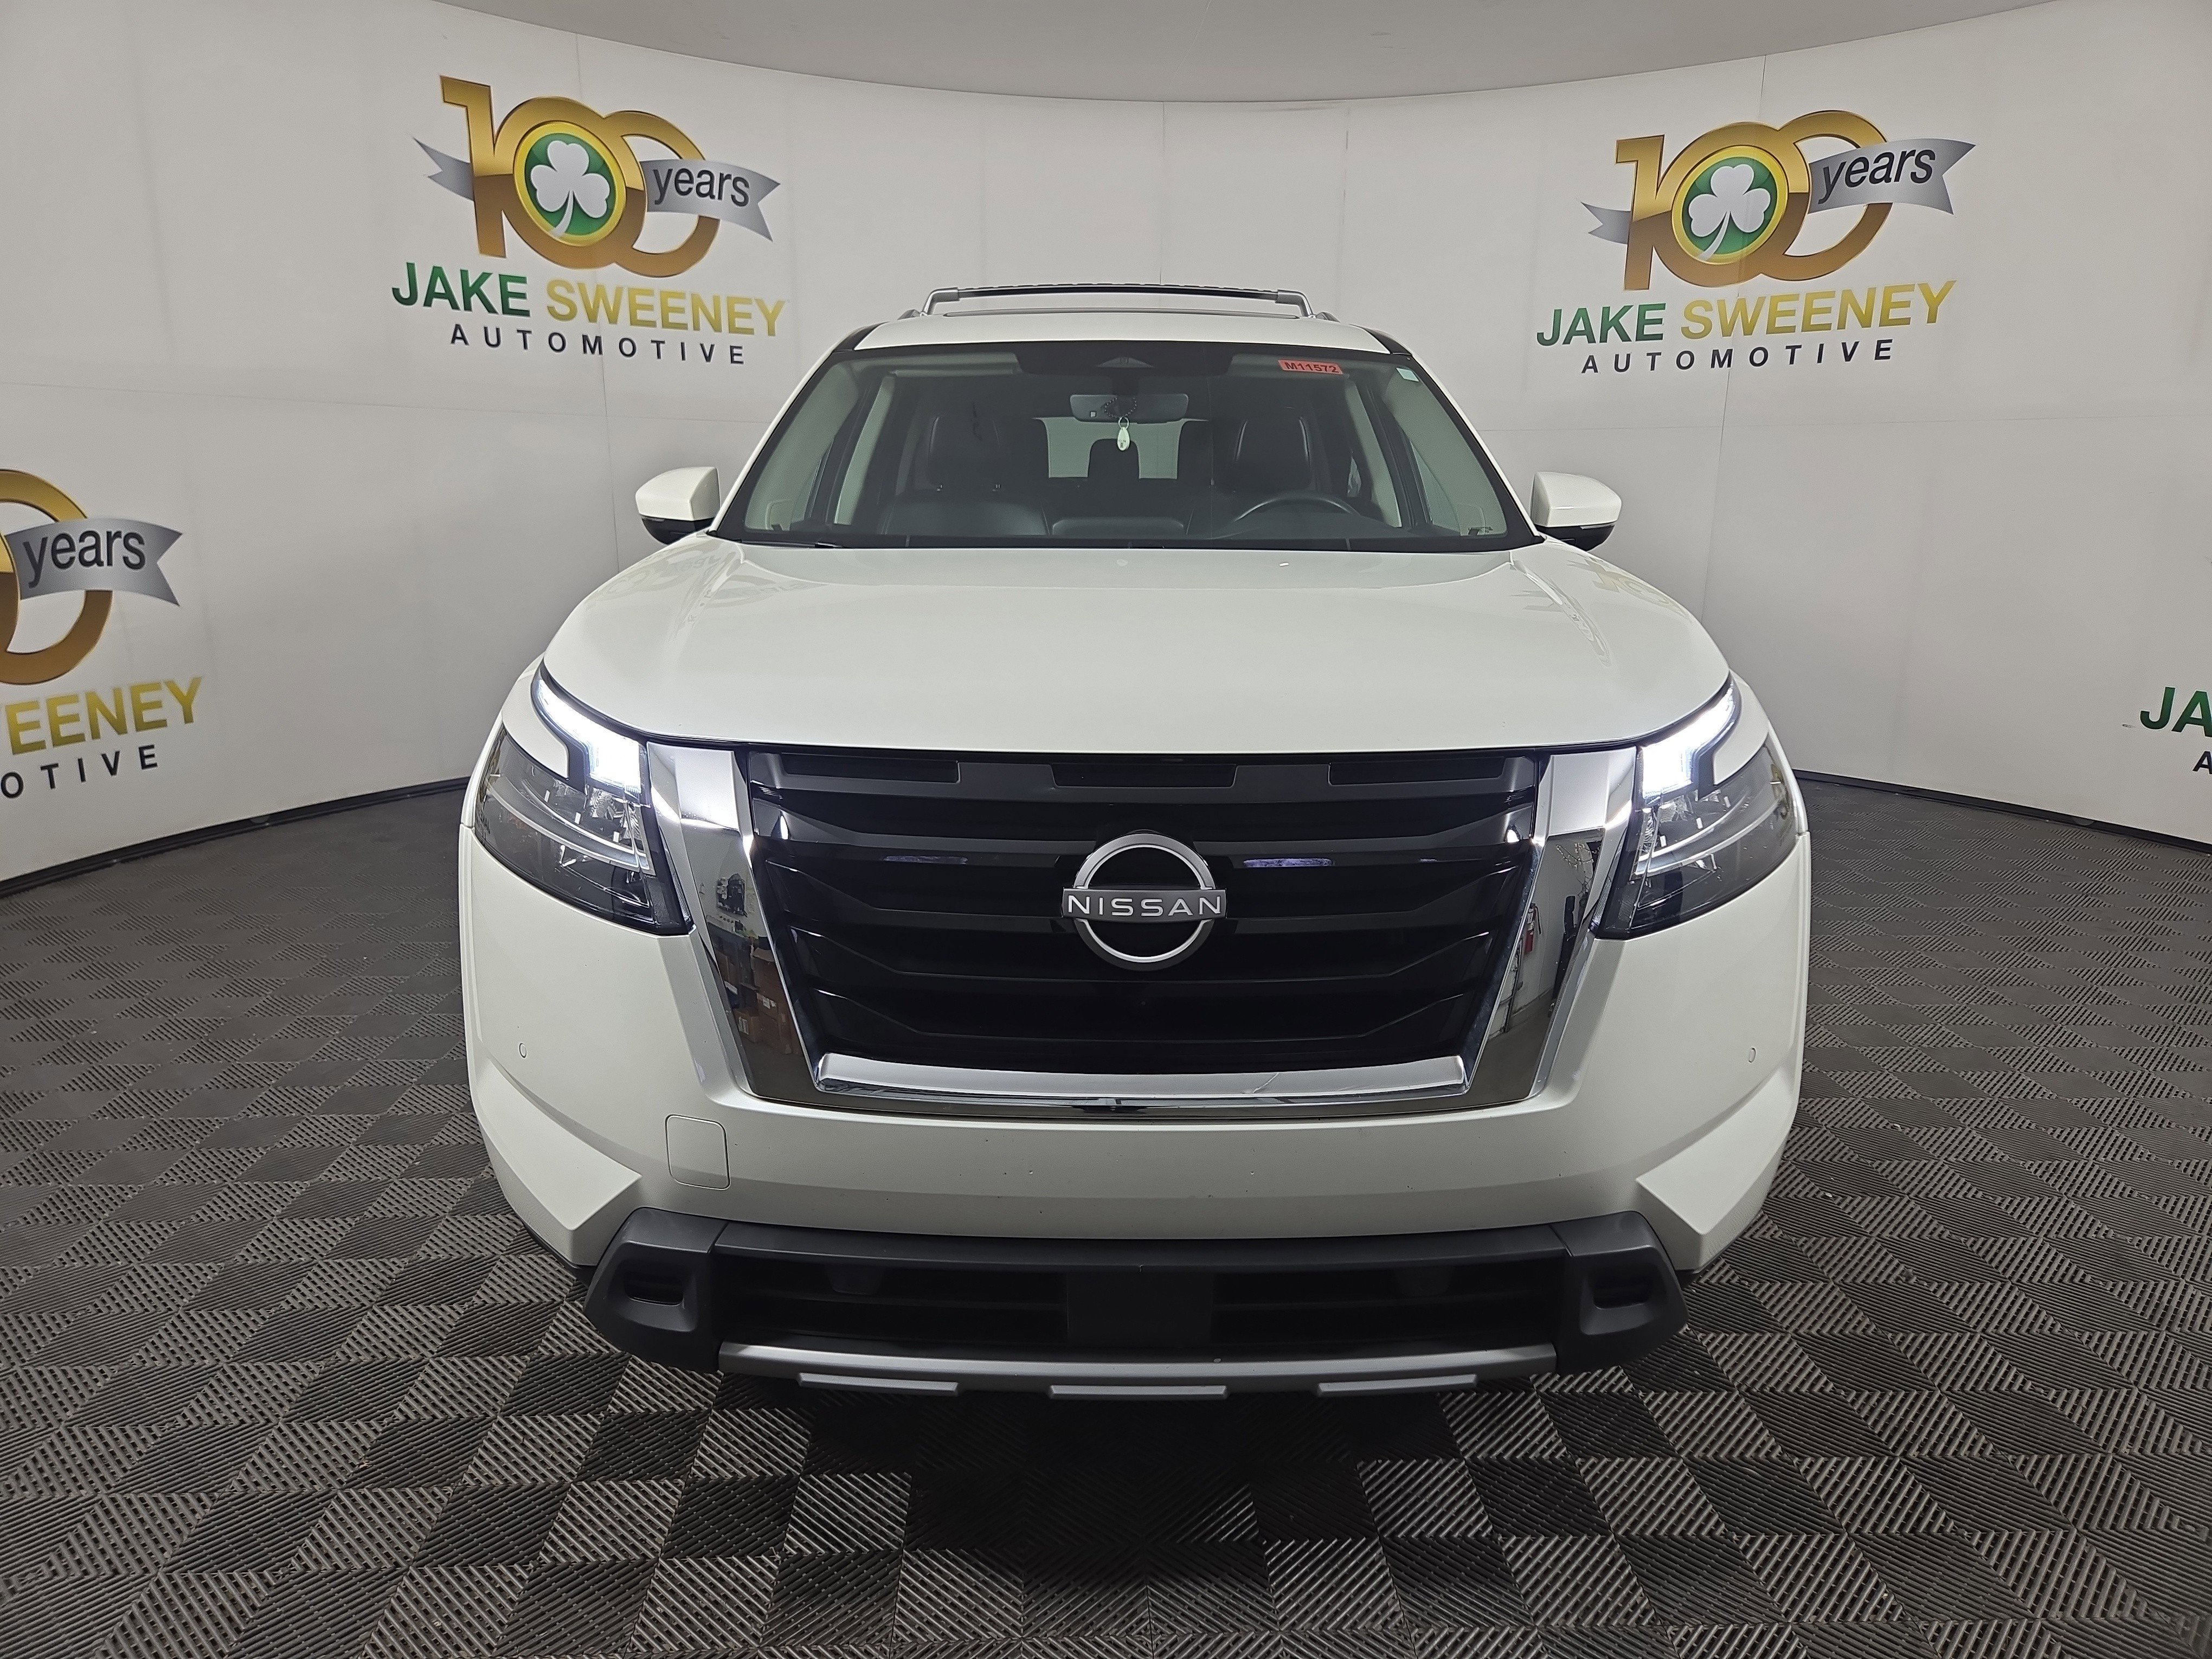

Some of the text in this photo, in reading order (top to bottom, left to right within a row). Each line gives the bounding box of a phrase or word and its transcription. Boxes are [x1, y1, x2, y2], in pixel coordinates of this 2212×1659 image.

[652, 168, 750, 207] years
[1817, 149, 1937, 204] years
[391, 262, 786, 337] JAKE SWEENEY
[1536, 280, 1957, 346] JAKE SWEENEY
[451, 324, 744, 364] AUTOMOTIVE
[1581, 338, 1894, 374] AUTOMOTIVE
[1284, 362, 1339, 373] M11572
[23, 530, 146, 588] years
[1068, 895, 1221, 917] NISSAN
